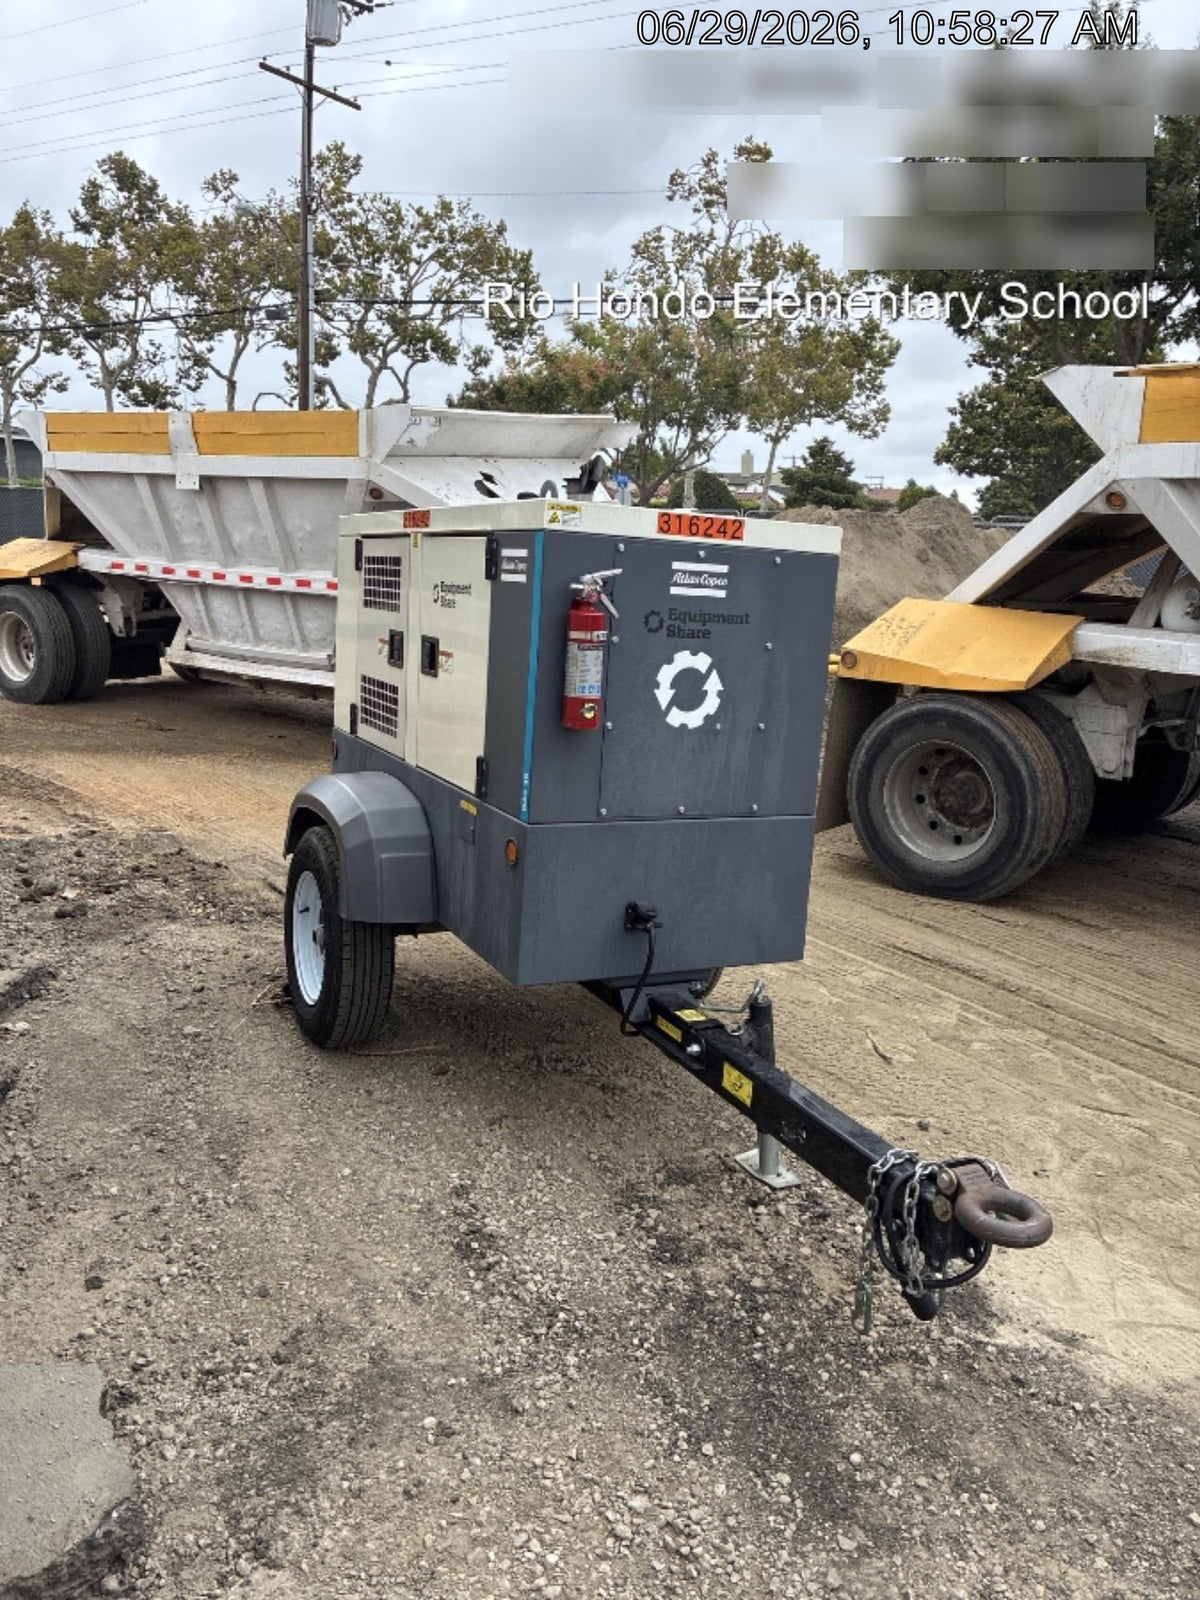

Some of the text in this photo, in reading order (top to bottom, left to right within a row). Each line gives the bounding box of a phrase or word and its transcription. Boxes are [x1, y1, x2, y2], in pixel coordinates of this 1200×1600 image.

[660, 513, 743, 539] 316242
[667, 607, 751, 627] Equipment
[666, 623, 712, 639] Share
